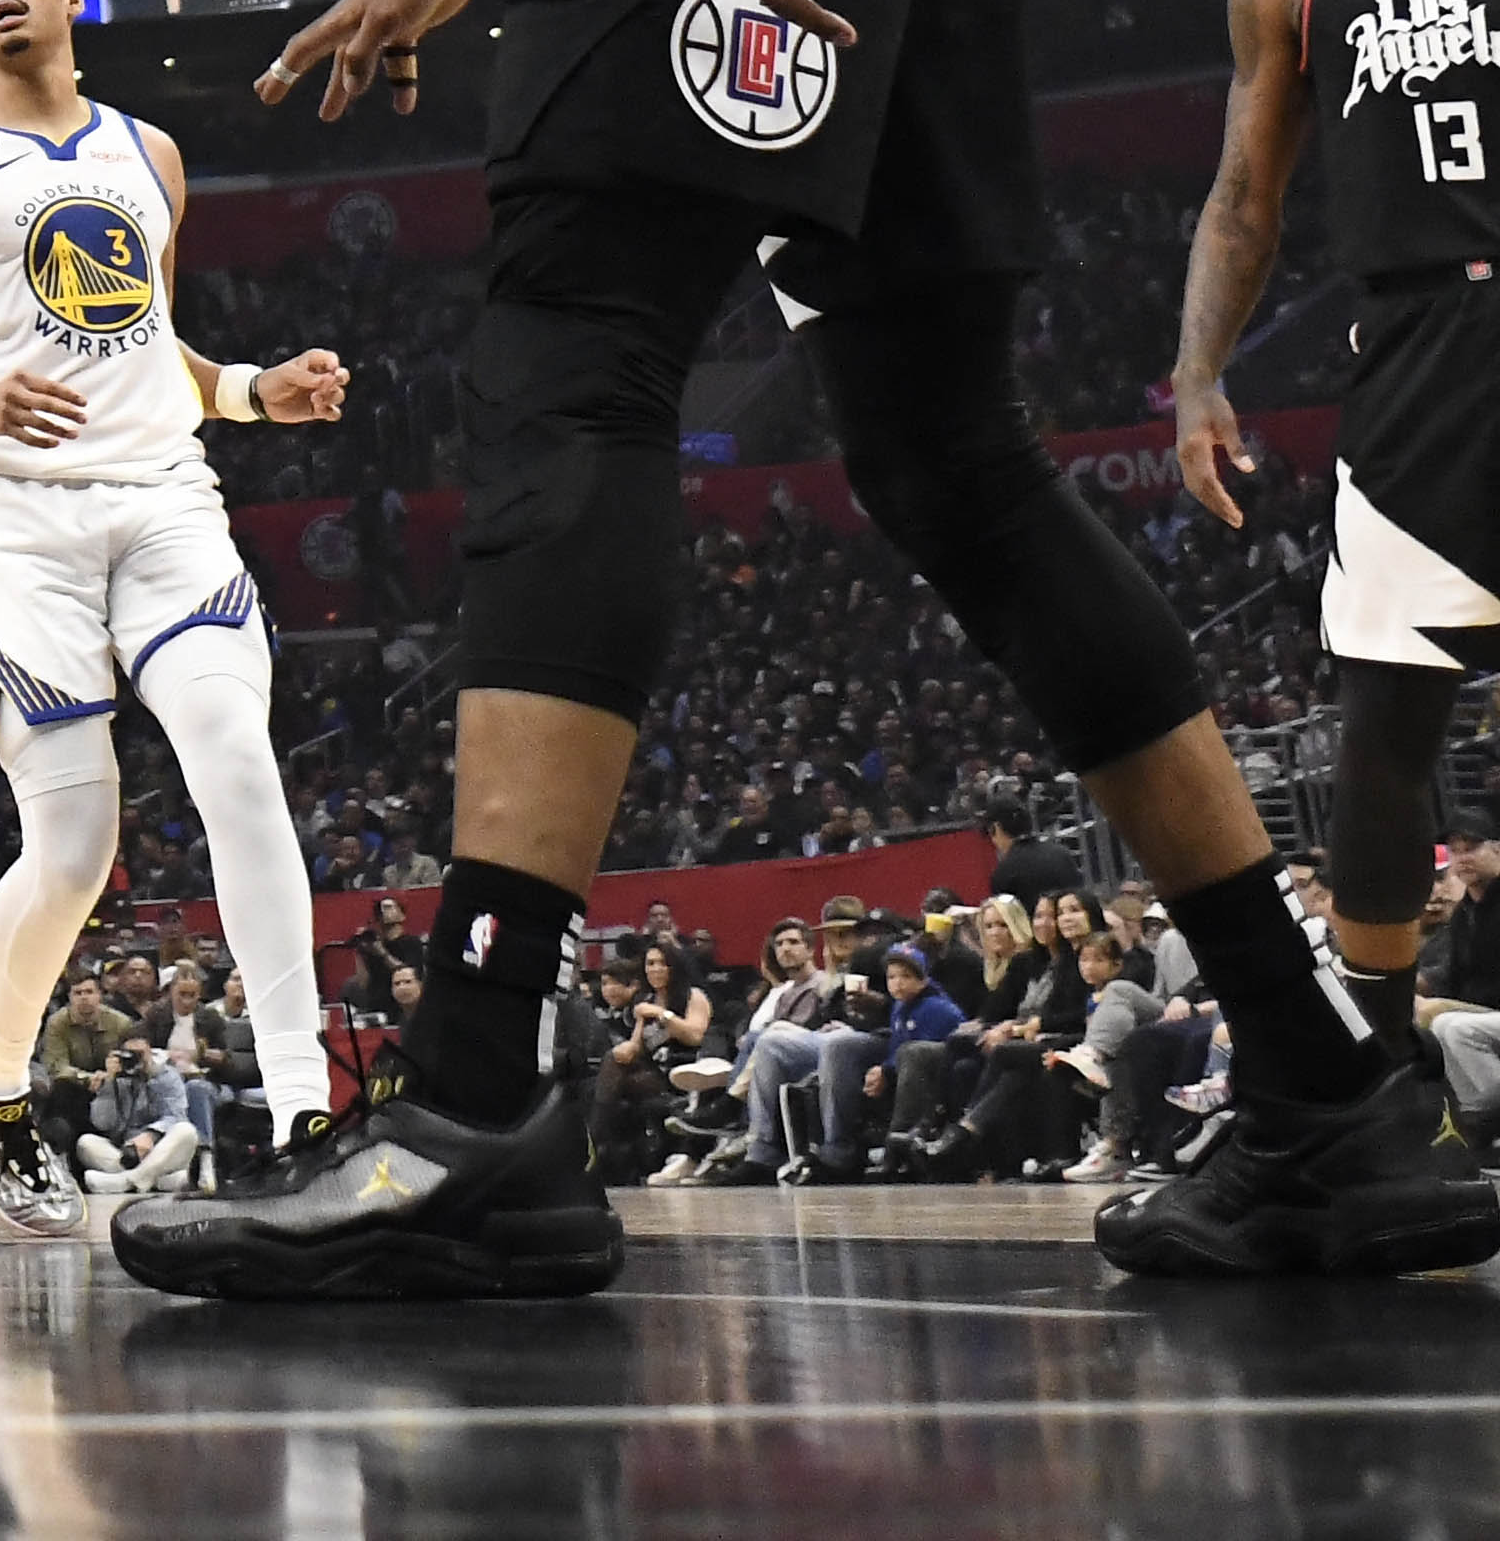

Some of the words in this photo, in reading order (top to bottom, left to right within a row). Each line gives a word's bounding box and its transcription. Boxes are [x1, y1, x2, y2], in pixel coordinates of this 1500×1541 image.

[1342, 3, 1500, 120] Angel
[1413, 100, 1486, 183] 13
[14, 183, 82, 228] GOLDEN
[93, 185, 147, 222] STATE
[104, 228, 132, 267] 3
